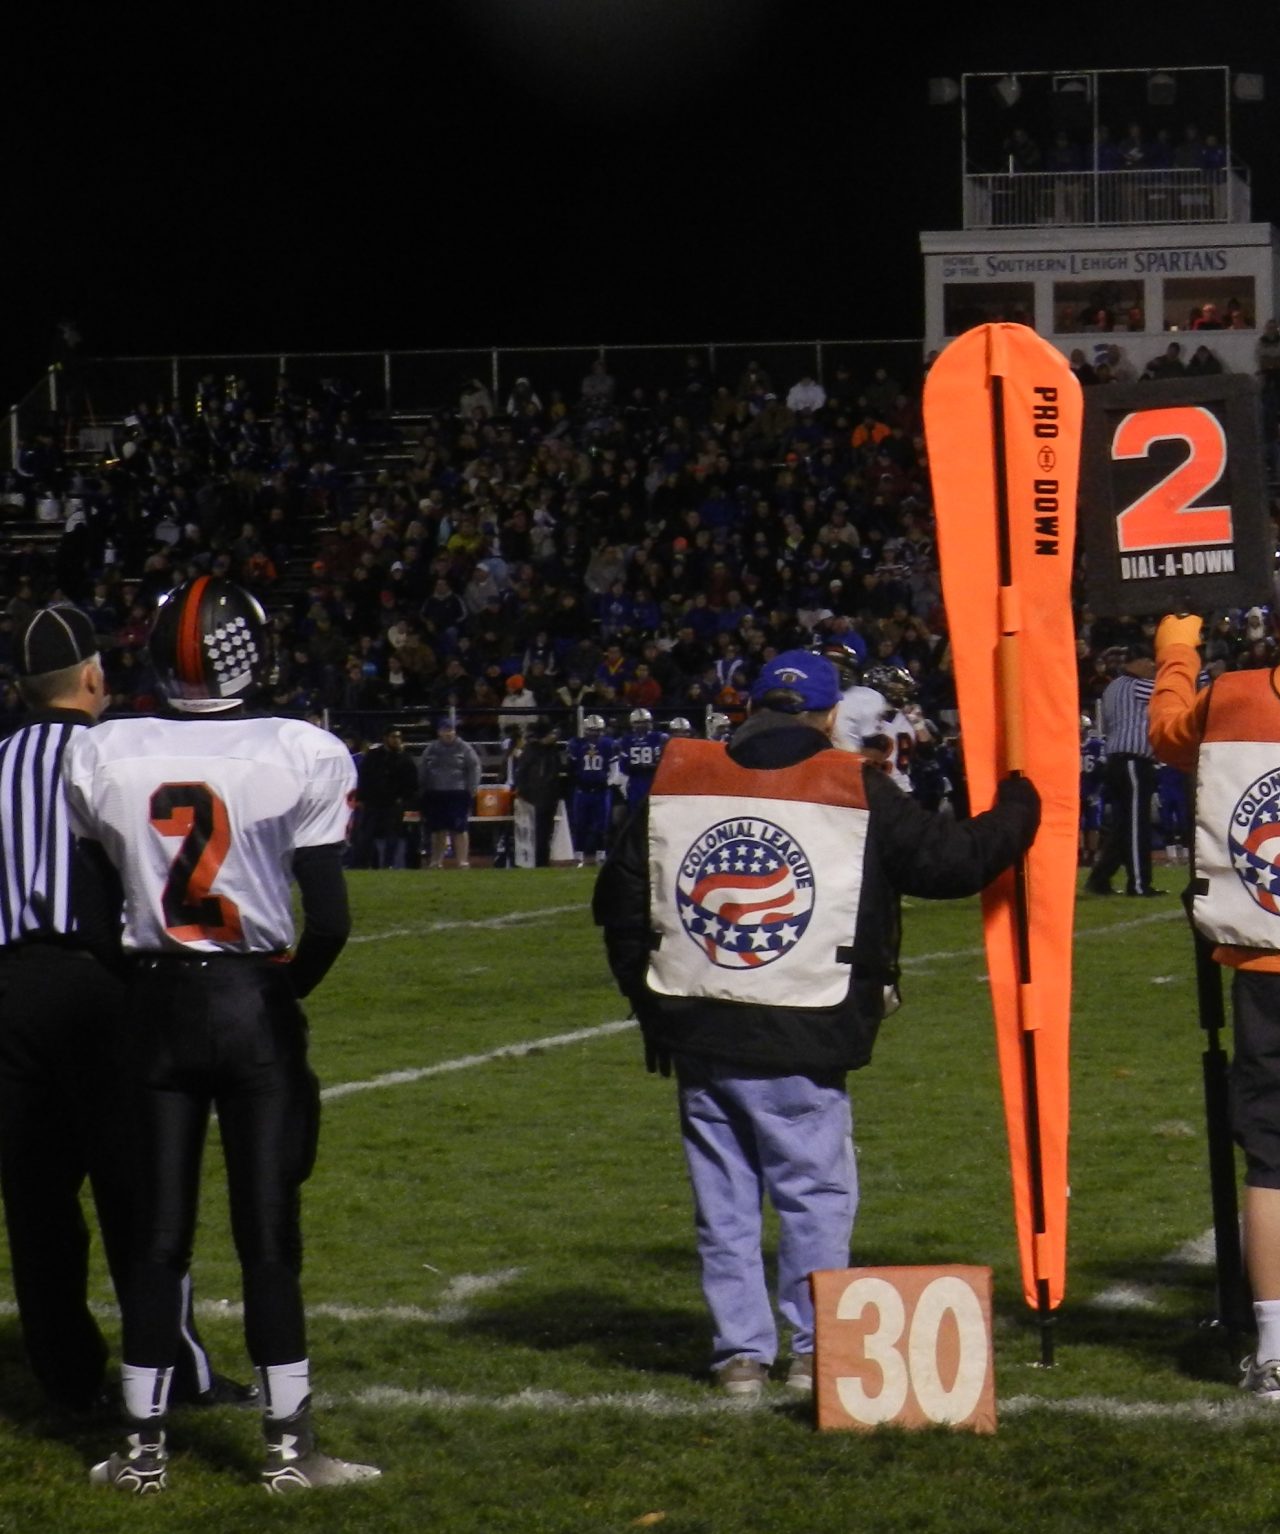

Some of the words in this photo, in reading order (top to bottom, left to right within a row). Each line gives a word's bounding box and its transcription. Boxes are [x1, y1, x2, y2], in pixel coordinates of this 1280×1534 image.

[986, 255, 1067, 277] SOUTHERN
[1070, 253, 1127, 274] LEHIGH
[1134, 250, 1228, 273] SPARTANS
[1033, 386, 1060, 439] PRO
[1111, 406, 1234, 553] 2
[1033, 479, 1060, 556] DOWN
[1120, 549, 1235, 580] DIAL-A-DOWN
[583, 754, 604, 772] 10
[629, 746, 653, 765] 58
[149, 781, 246, 943] 2
[683, 821, 755, 879] COLONIAL
[760, 826, 814, 890] LEAGUE
[835, 1276, 989, 1426] 30
